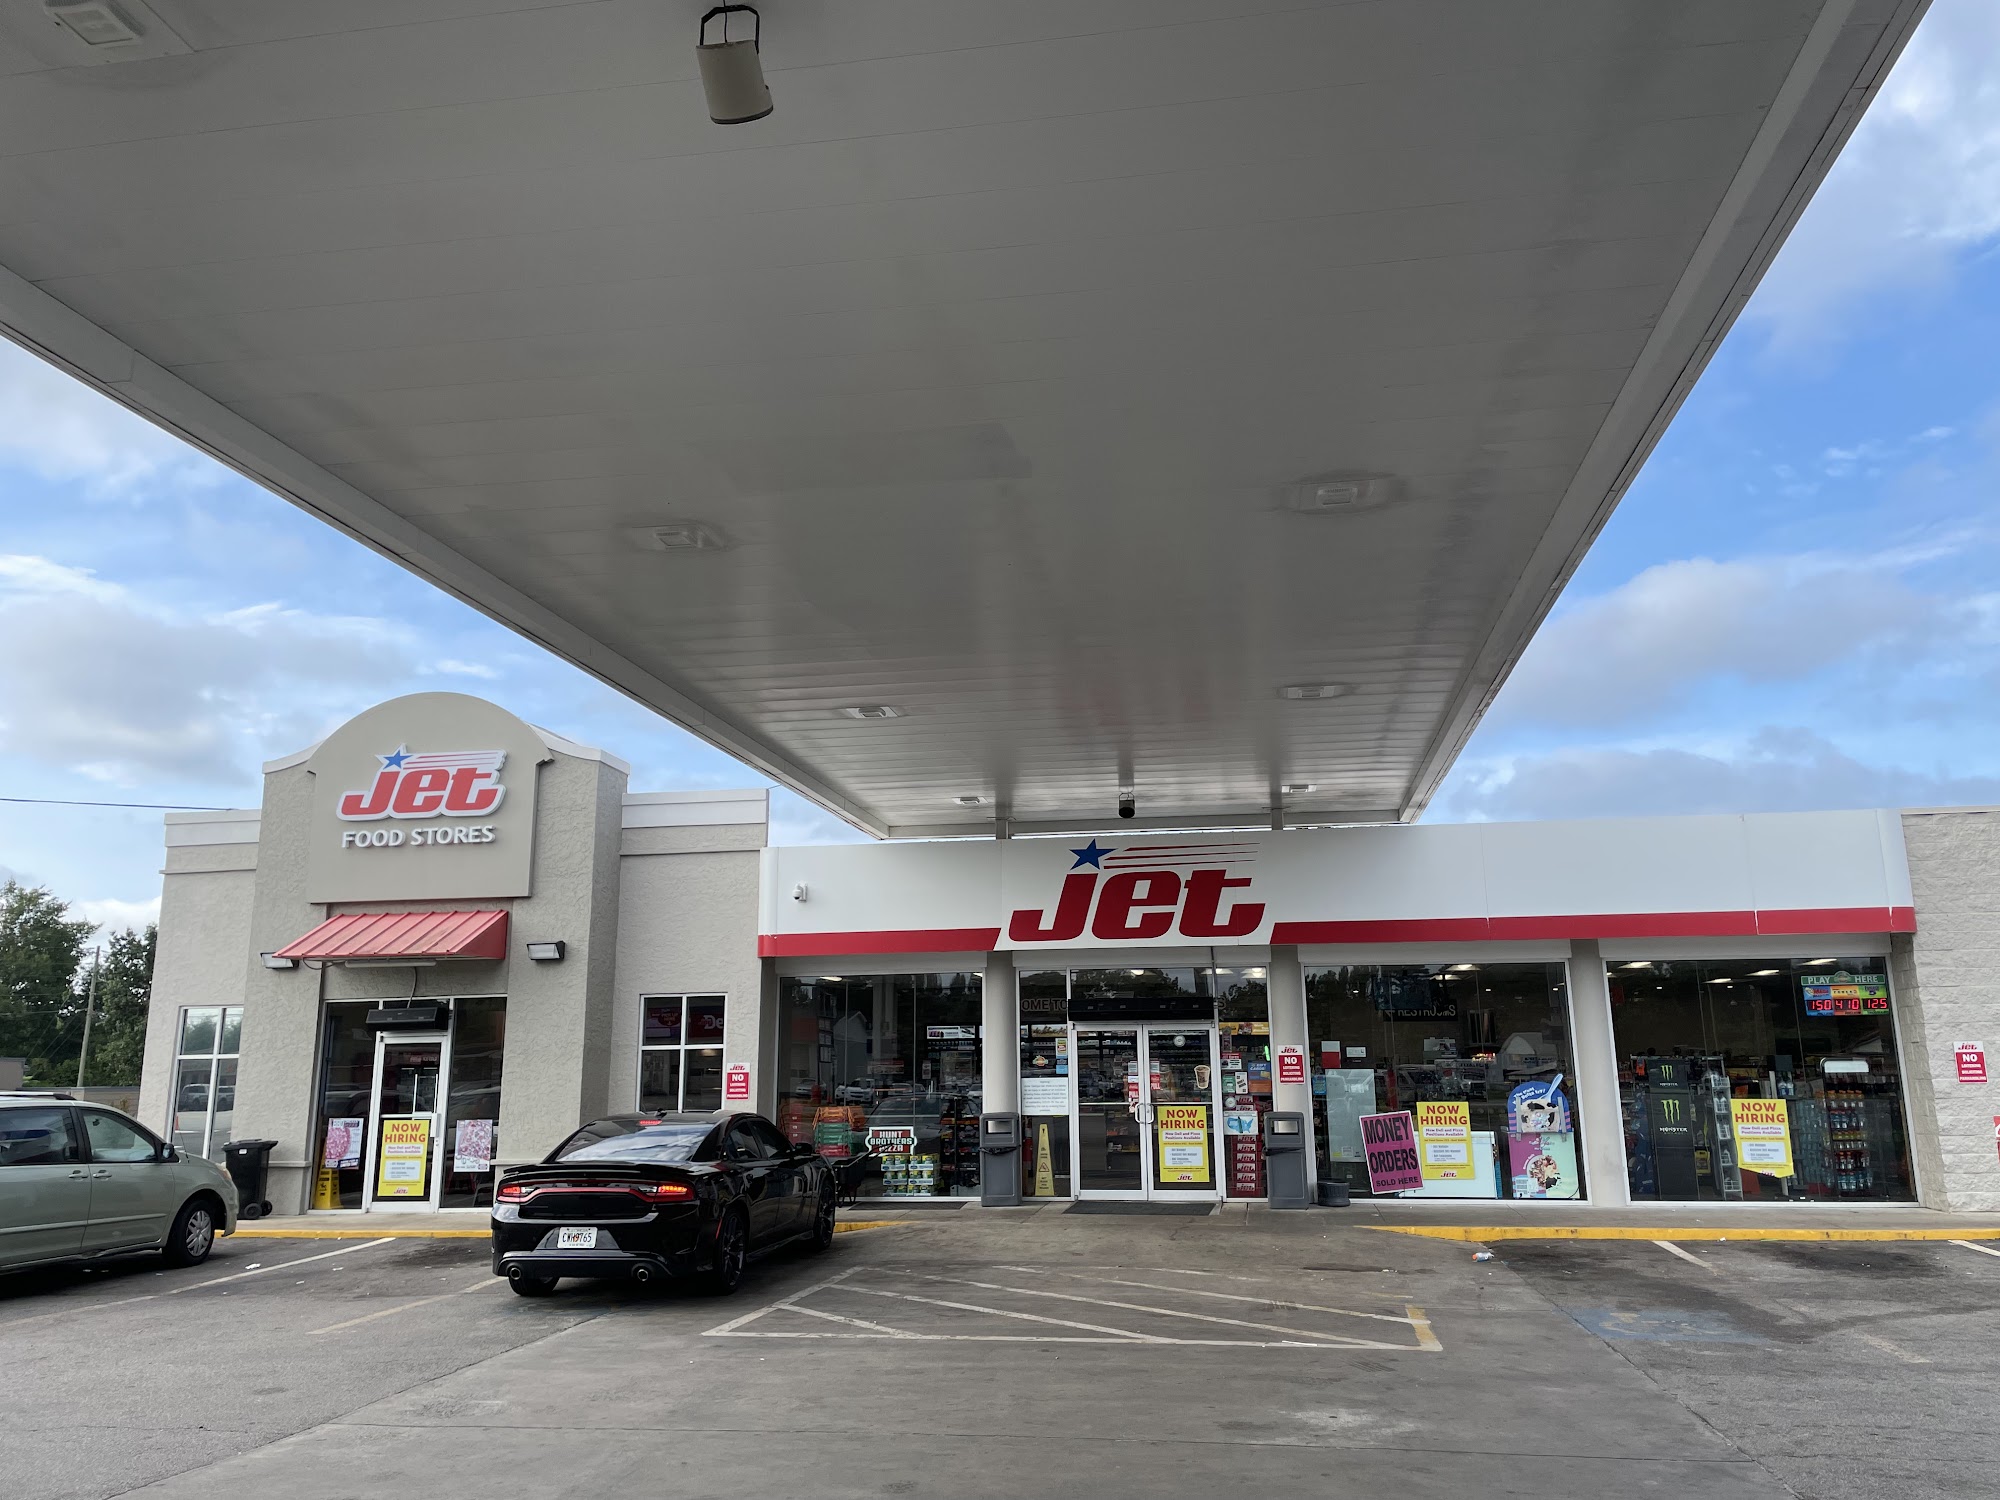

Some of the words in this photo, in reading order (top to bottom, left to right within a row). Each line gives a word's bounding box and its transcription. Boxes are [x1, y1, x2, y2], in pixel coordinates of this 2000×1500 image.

[341, 829, 404, 848] FOOD
[410, 825, 496, 845] STORES
[1807, 976, 1831, 984] PLAY
[1854, 975, 1878, 983] HERE
[1812, 1000, 1832, 1010] 150
[1867, 998, 1887, 1009] 125
[1284, 1056, 1298, 1065] NO
[1962, 1053, 1978, 1062] NO
[731, 1073, 745, 1082] NO
[1426, 1105, 1459, 1115] NOW
[1741, 1102, 1777, 1112] NOW
[1166, 1109, 1198, 1119] NOW
[1735, 1113, 1785, 1123] HIRING
[1160, 1119, 1205, 1129] HIRING
[1420, 1116, 1468, 1125] HIRING
[391, 1123, 421, 1133] NOW
[1363, 1115, 1409, 1144] MONEY
[384, 1133, 426, 1143] HIRING
[870, 1137, 913, 1145] BROTHERS
[1369, 1148, 1418, 1174] ORDERS
[1376, 1179, 1396, 1187] SOLD
[1398, 1176, 1419, 1185] HERE
